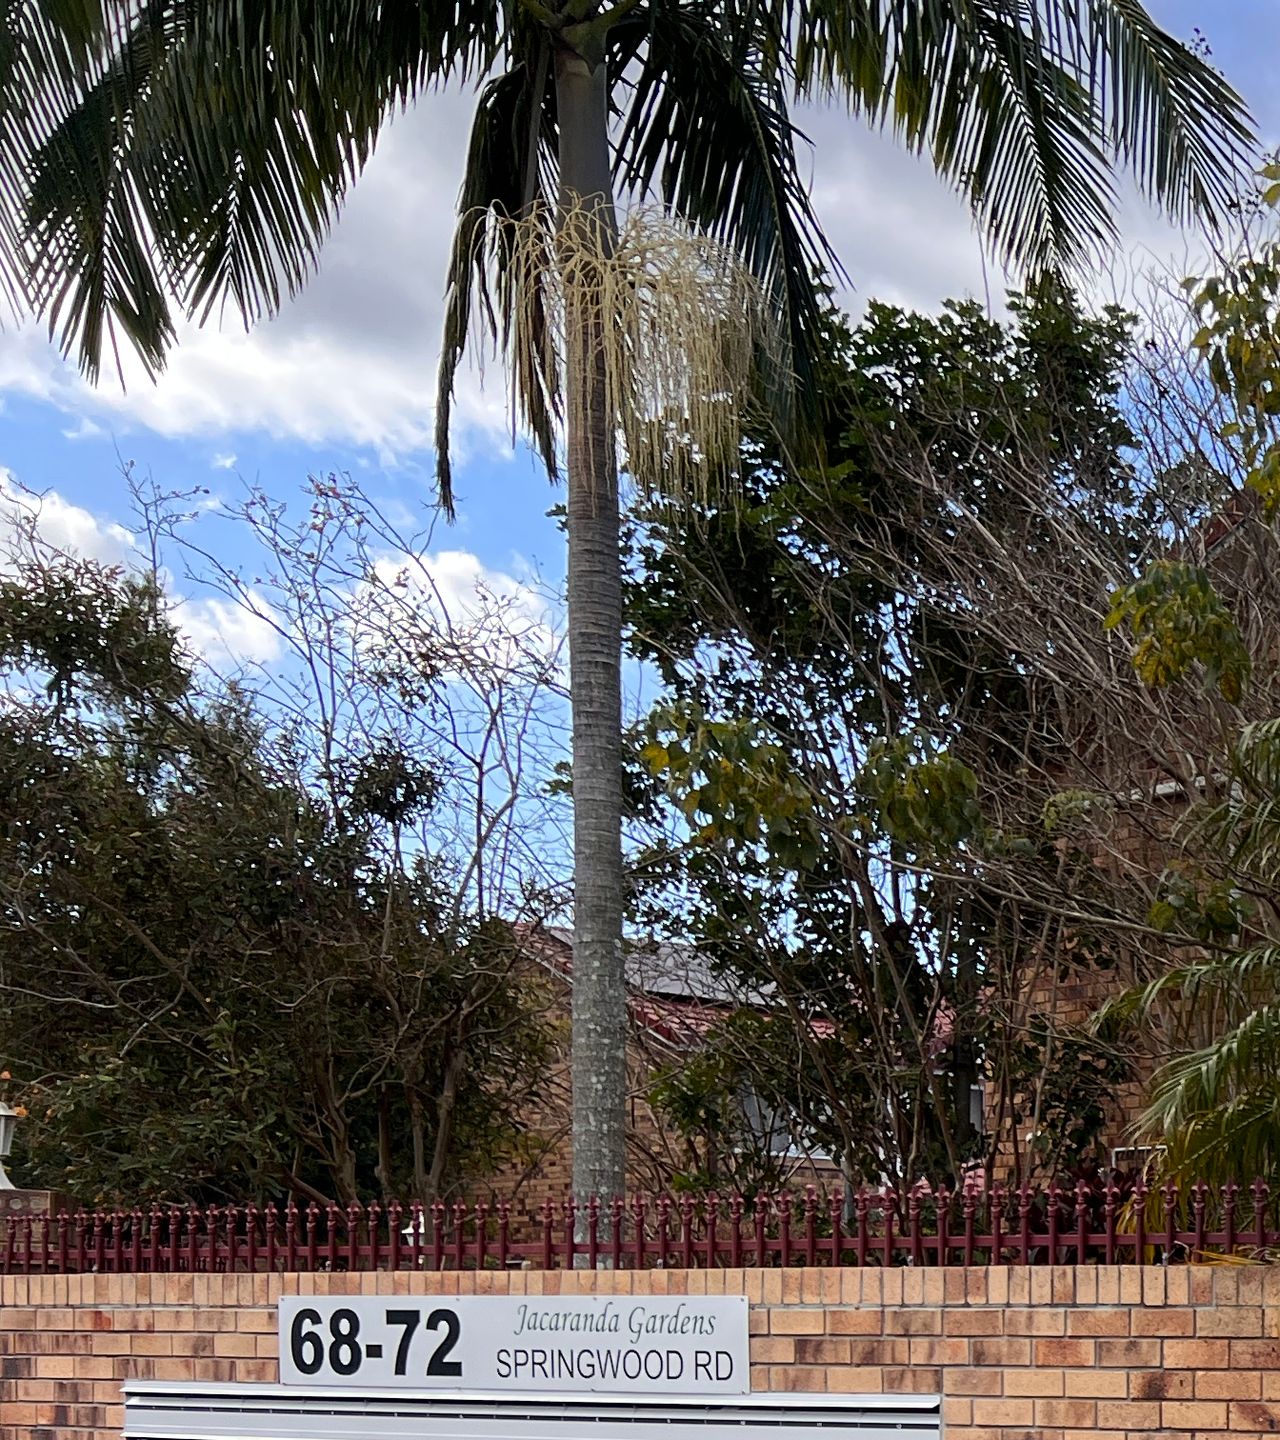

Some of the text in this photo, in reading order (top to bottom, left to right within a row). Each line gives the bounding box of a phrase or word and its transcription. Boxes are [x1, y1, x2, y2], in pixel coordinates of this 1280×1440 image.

[290, 1308, 463, 1377] 68-72
[513, 1301, 717, 1343] Jacaranda Gardens
[496, 1348, 735, 1381] SPRINGWOOD RD
